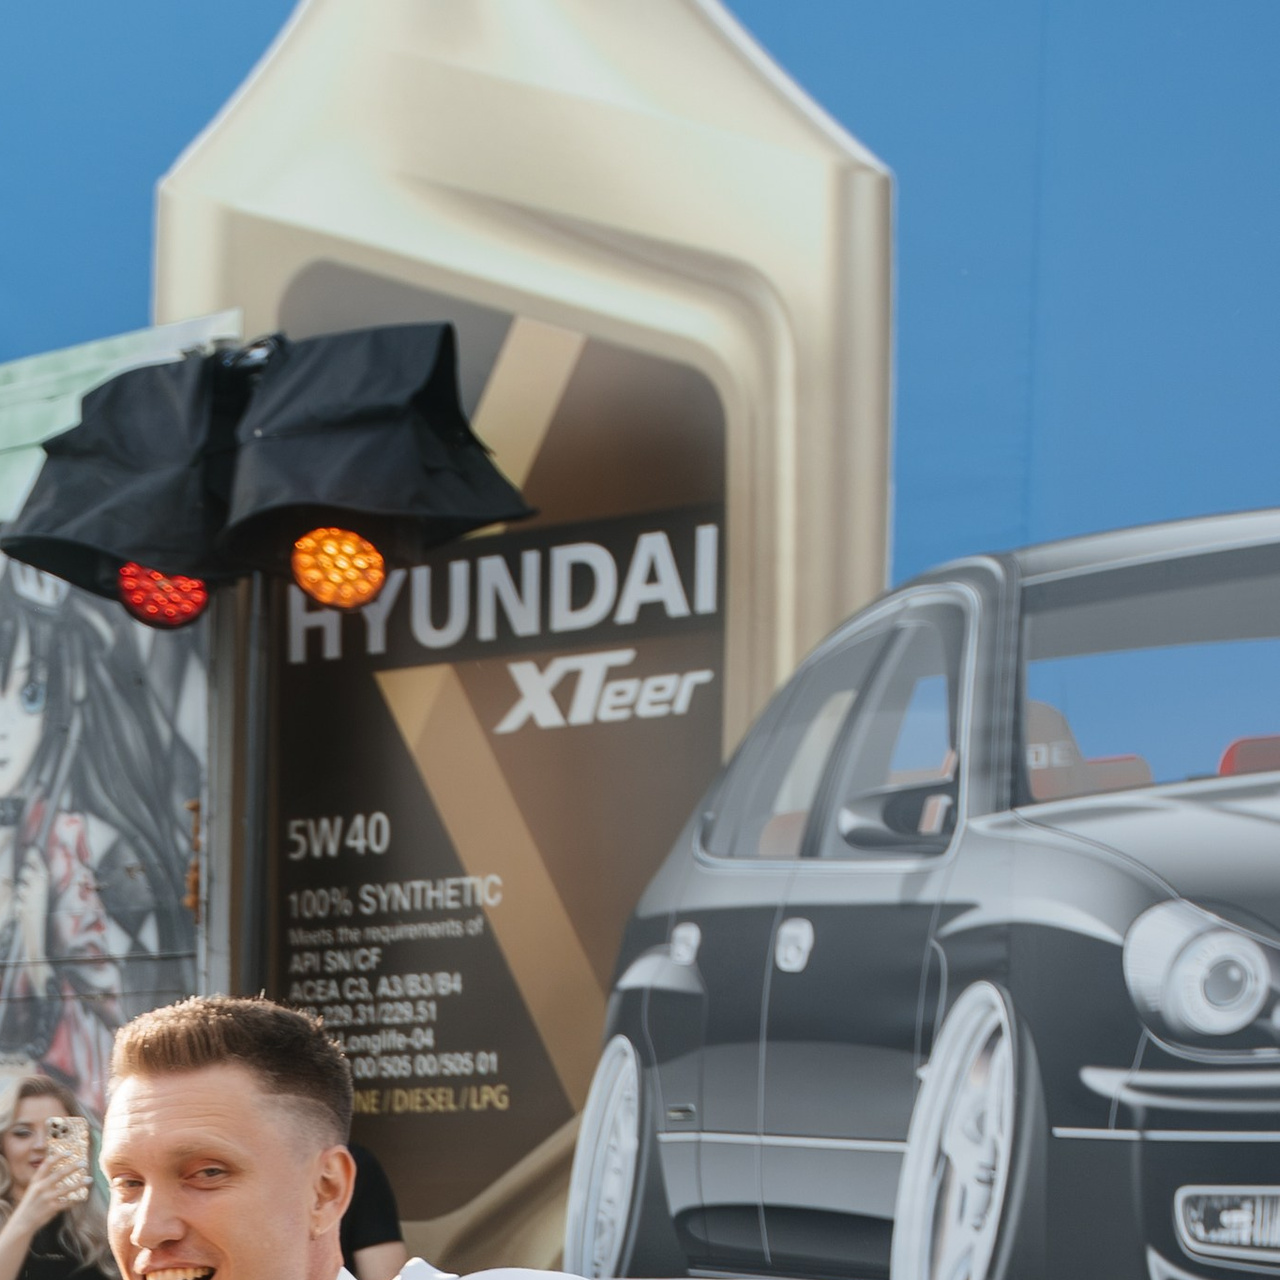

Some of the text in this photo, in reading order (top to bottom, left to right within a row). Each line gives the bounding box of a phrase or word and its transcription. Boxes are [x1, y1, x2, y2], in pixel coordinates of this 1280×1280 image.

[286, 523, 719, 664] HYUNDAI
[492, 648, 715, 735] XTeer
[288, 873, 503, 918] 100% SYNTHETIC
[336, 925, 362, 943] the
[363, 919, 464, 945] requirements
[466, 914, 484, 936] of
[288, 951, 320, 974] API
[288, 978, 340, 1001] ACEA
[475, 1051, 499, 1075] 01
[391, 1086, 457, 1112] DIESEL
[469, 1084, 510, 1111] LPG
